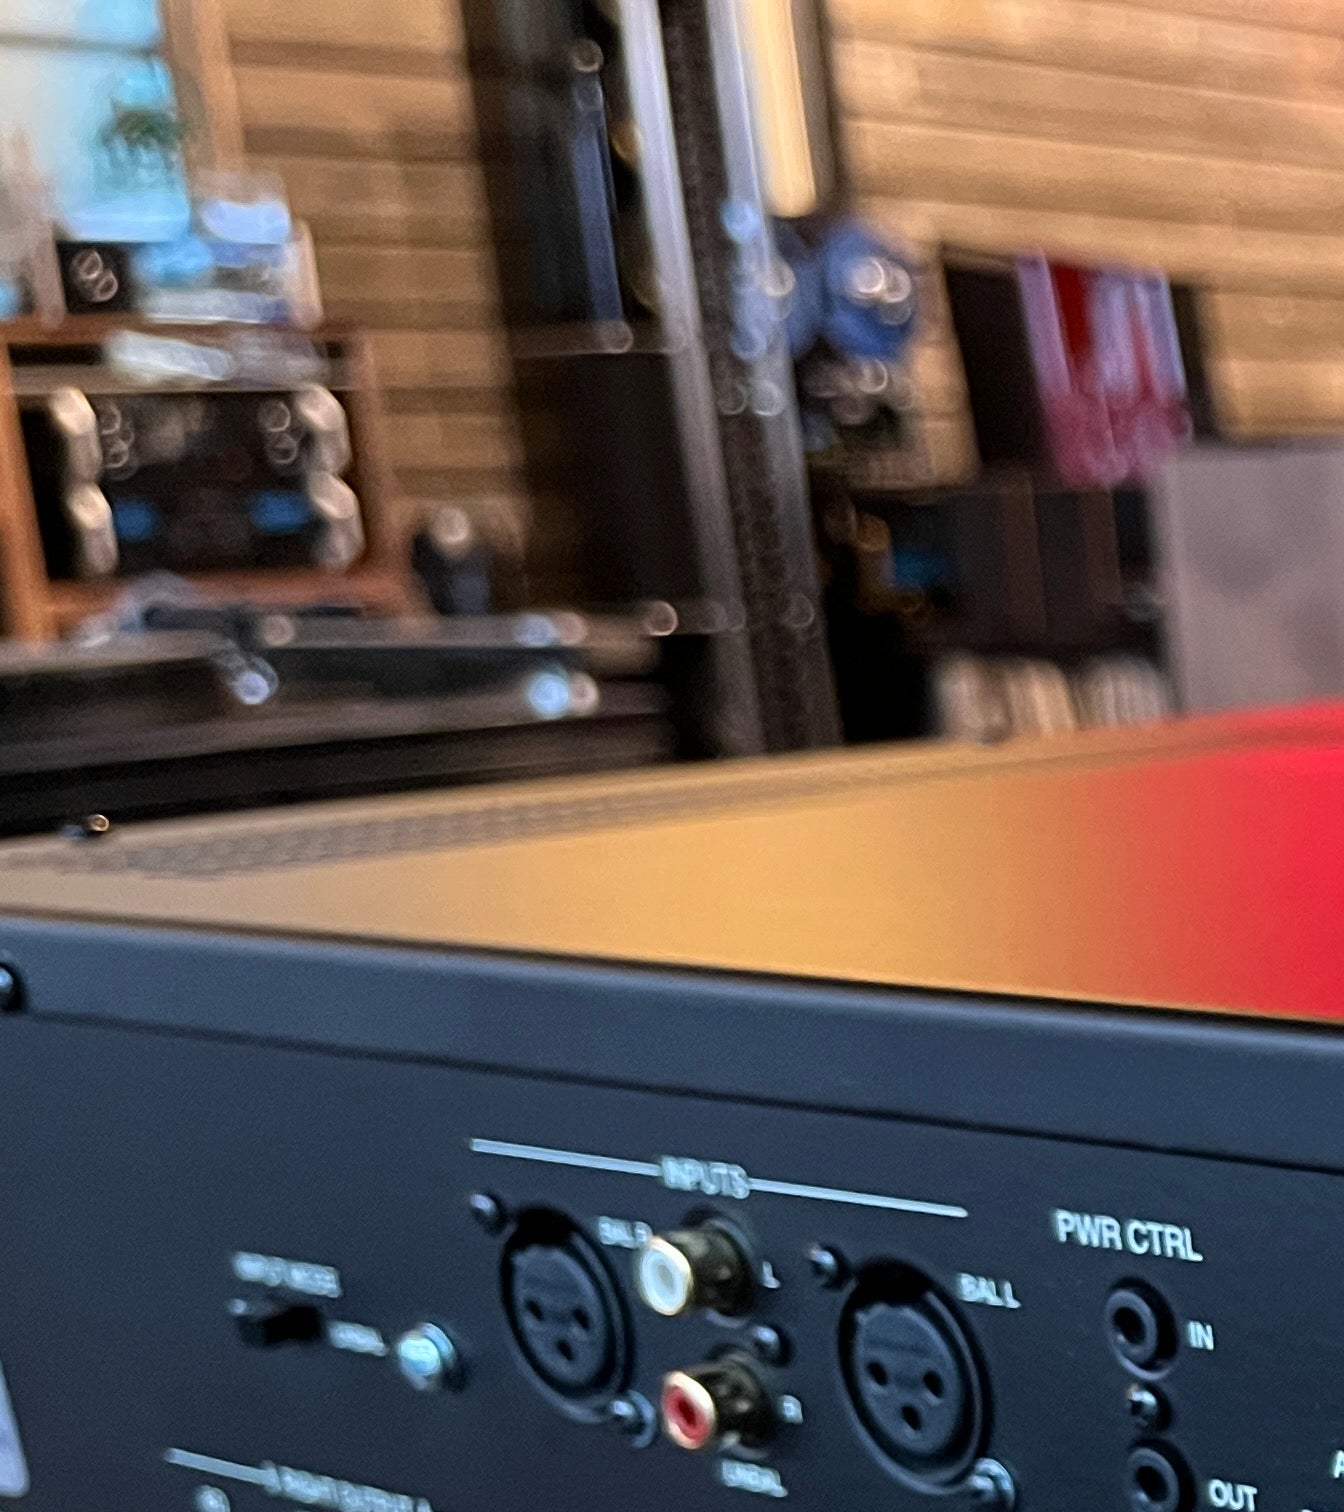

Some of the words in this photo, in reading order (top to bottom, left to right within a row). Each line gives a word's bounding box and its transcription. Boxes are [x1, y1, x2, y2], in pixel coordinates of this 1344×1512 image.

[1054, 1208, 1122, 1250] PWR
[1126, 1219, 1204, 1262] CTRL
[1186, 1321, 1214, 1351] IN
[1208, 1479, 1258, 1512] OUT
